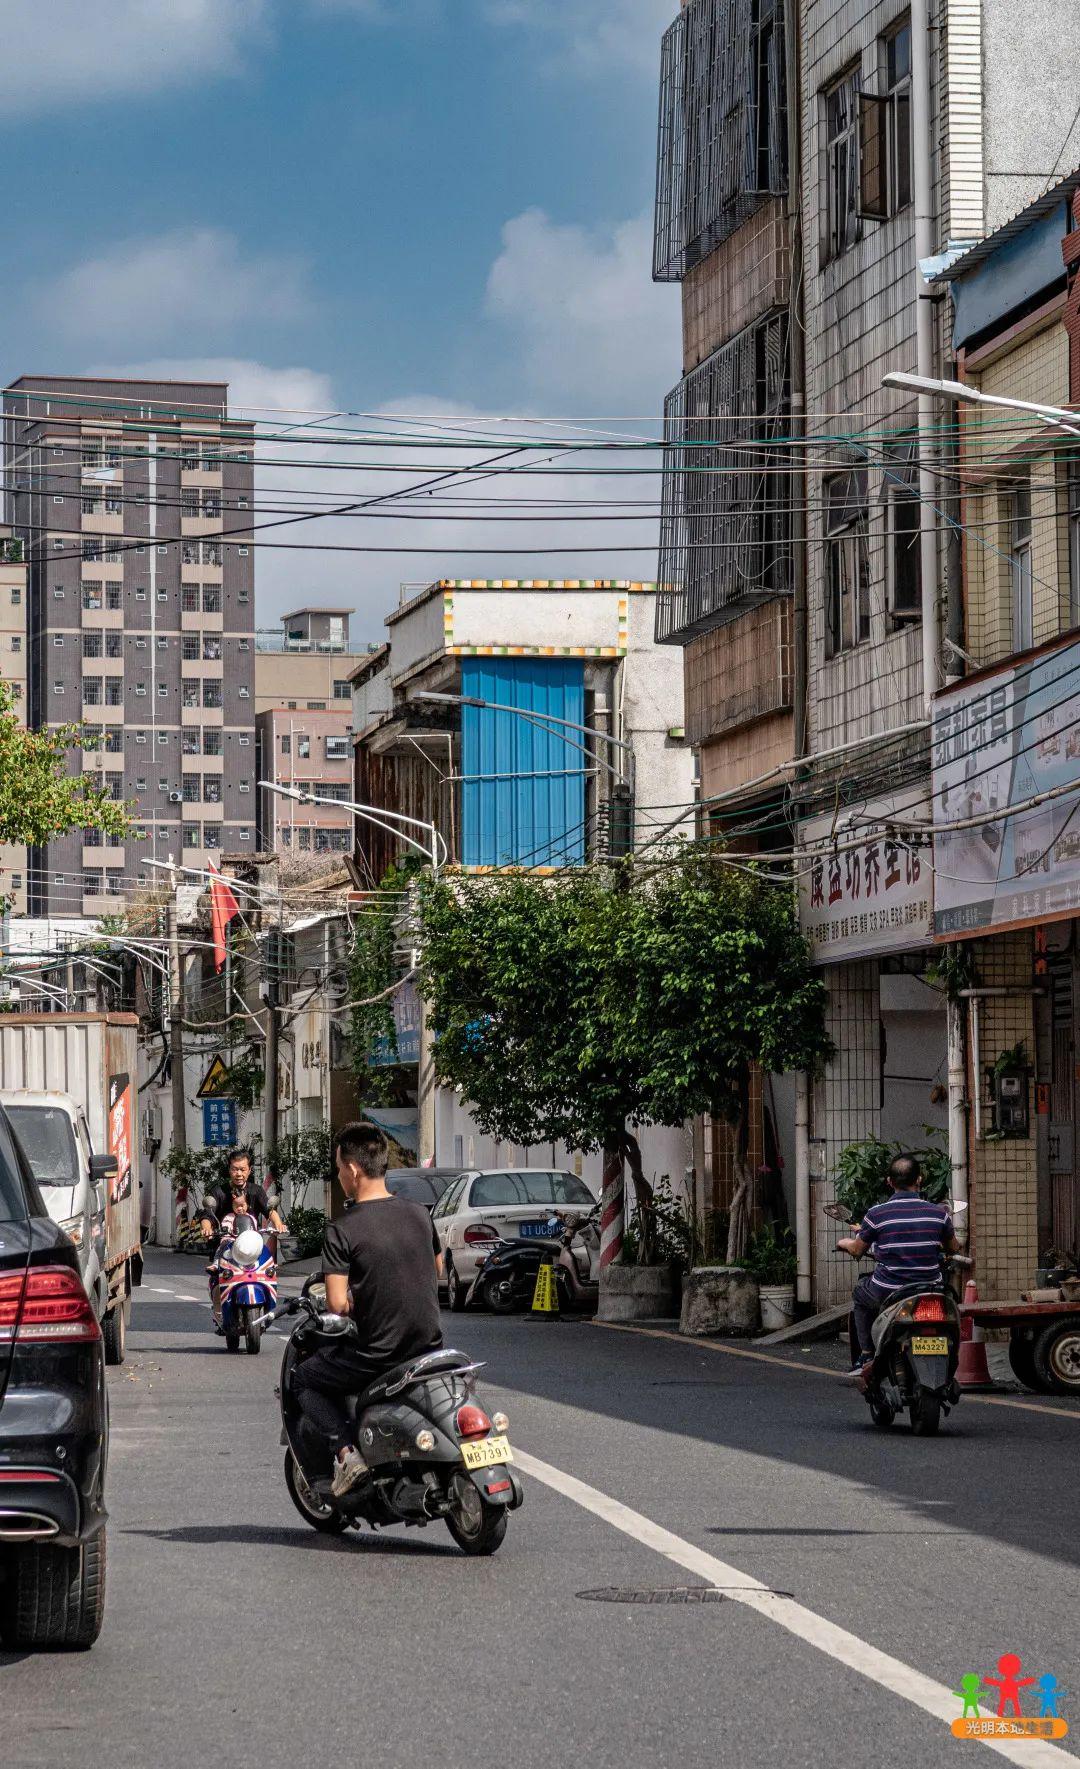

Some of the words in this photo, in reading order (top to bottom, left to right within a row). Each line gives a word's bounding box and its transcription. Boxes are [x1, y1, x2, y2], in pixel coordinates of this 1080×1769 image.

[210, 1103, 219, 1141] 前方施工
[466, 1446, 508, 1463] MB7391
